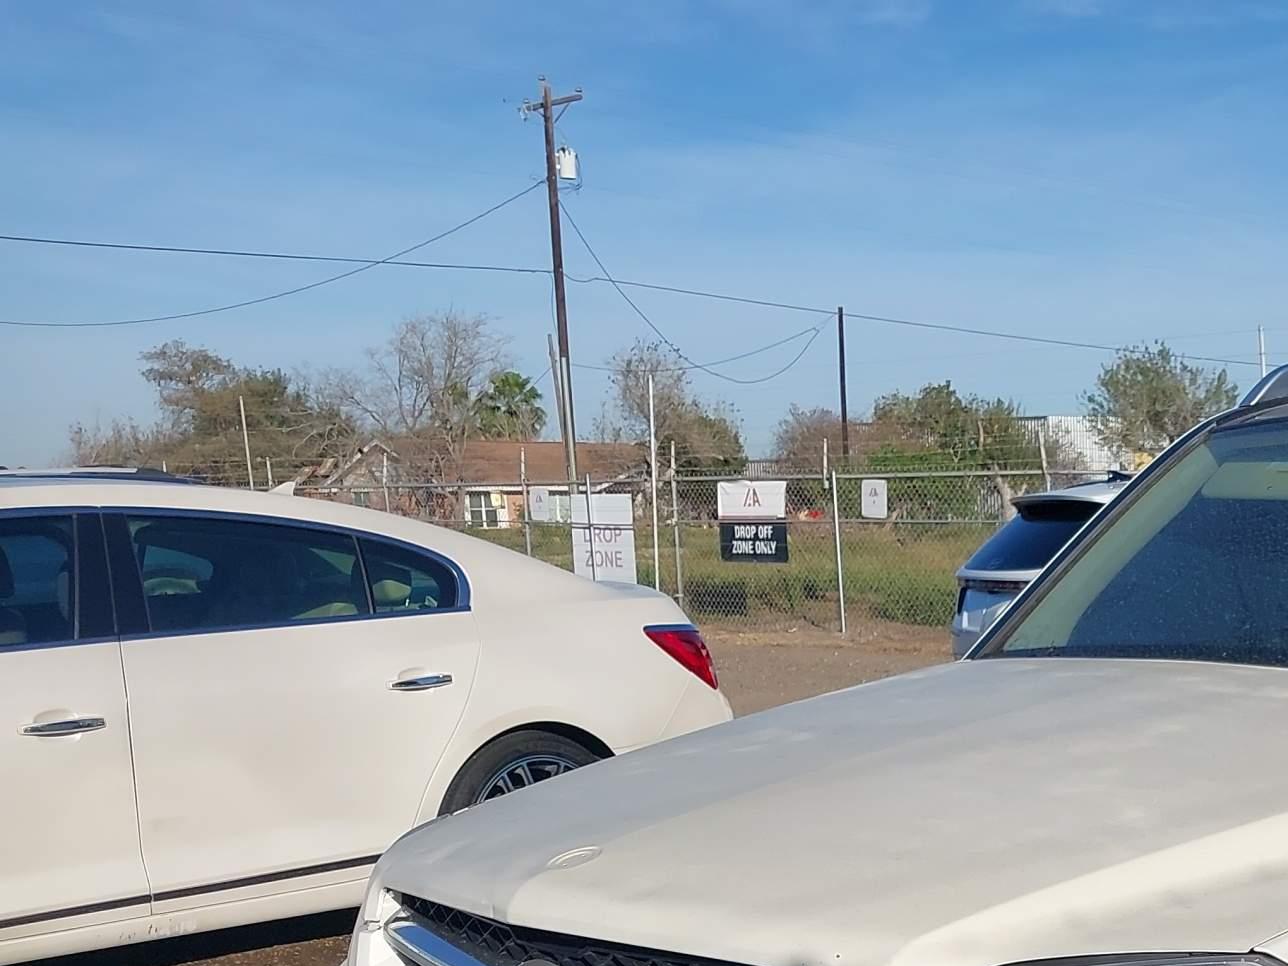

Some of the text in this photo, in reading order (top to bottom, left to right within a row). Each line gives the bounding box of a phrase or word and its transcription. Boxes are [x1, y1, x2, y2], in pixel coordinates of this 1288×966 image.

[734, 525, 773, 539] DROP OFF
[732, 541, 776, 554] ZONE ONLY
[585, 550, 623, 568] ZONE
